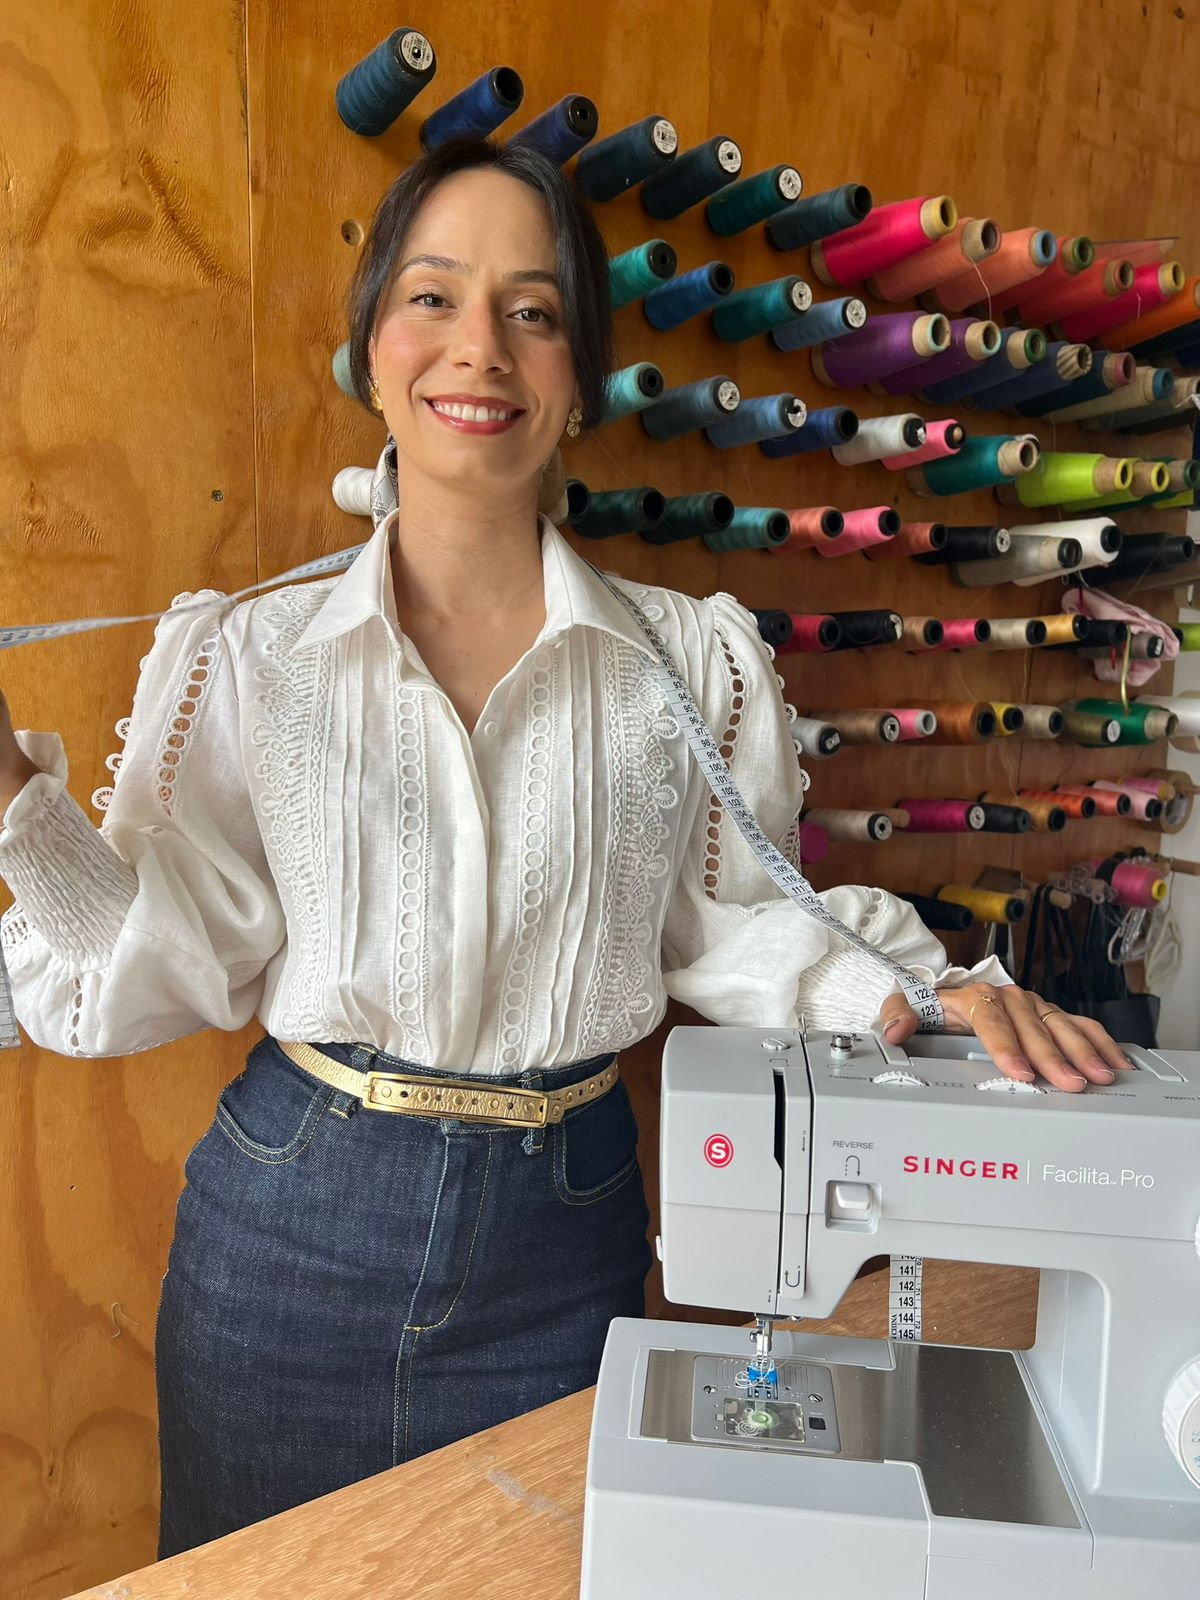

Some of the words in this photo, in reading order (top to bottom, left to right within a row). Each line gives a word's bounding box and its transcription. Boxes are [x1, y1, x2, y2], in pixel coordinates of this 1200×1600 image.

[673, 681, 682, 689] 93
[678, 692, 688, 701] 94
[683, 704, 693, 713] 95
[689, 716, 698, 724] 96
[695, 727, 704, 736] 97
[701, 739, 711, 747] 98
[707, 751, 716, 759] 99
[709, 763, 722, 772] 100
[715, 775, 728, 784] 101
[721, 787, 734, 796] 102
[728, 798, 741, 807] 103
[735, 810, 748, 818] 104
[742, 821, 755, 830] 105
[750, 833, 762, 841] 106
[757, 844, 770, 852] 107
[765, 854, 779, 863] 108
[773, 864, 788, 873] 109
[782, 874, 797, 884] 110
[791, 885, 806, 895] 111
[801, 896, 815, 905] 112
[906, 975, 920, 985] 121
[915, 988, 930, 1000] 122
[921, 1004, 936, 1017] 123
[832, 1140, 874, 1150] REVERSE
[903, 1155, 1018, 1180] SINGER
[1120, 1170, 1155, 1188] Pro
[900, 1266, 914, 1275] 141
[899, 1281, 914, 1291] 142
[899, 1297, 914, 1306] 143
[899, 1313, 914, 1323] 144
[899, 1329, 914, 1339] 145
